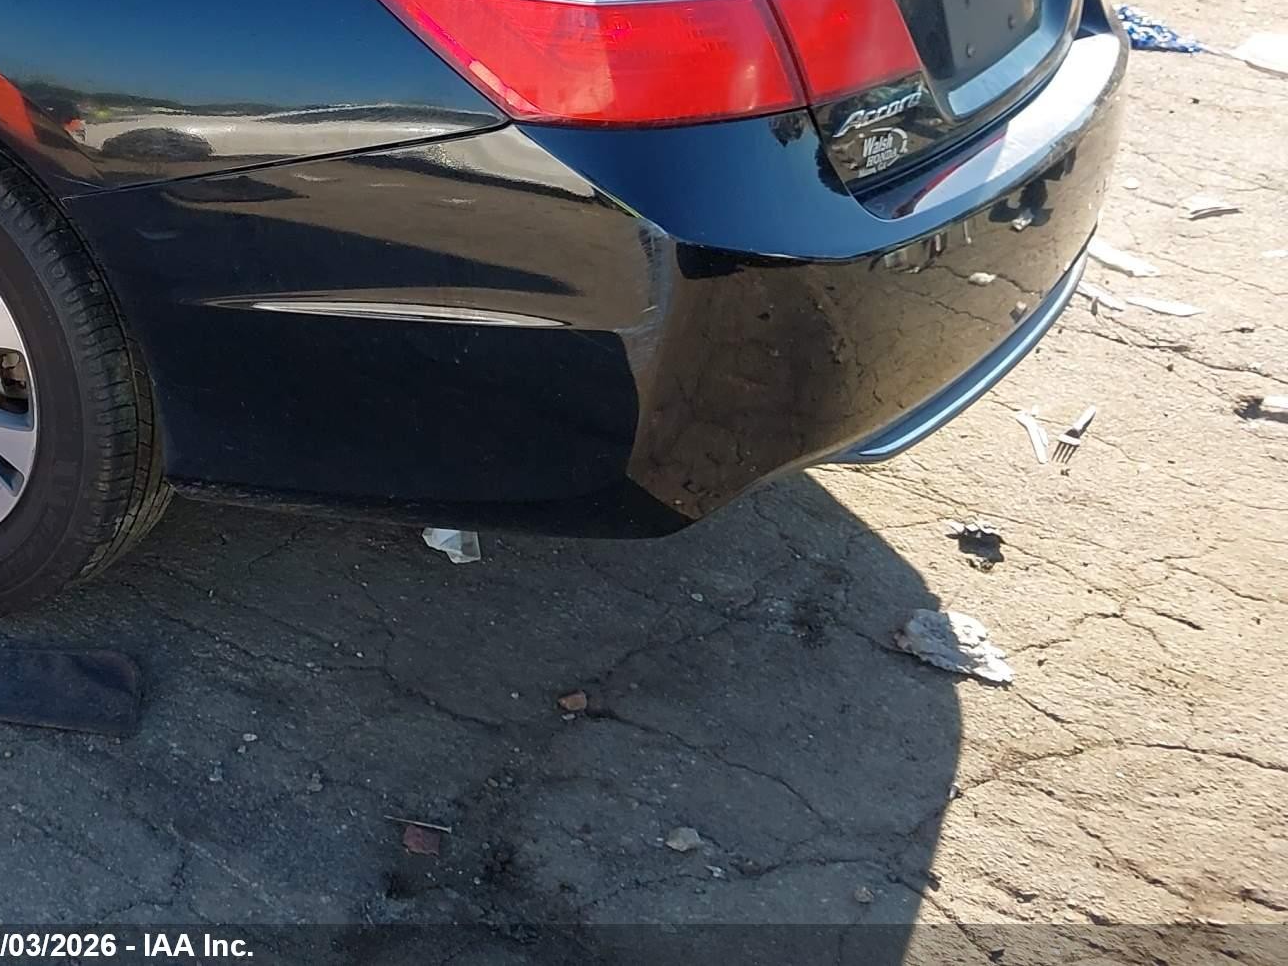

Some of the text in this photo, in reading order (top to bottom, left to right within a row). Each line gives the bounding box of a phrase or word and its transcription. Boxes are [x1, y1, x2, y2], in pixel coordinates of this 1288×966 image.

[832, 81, 928, 138] Accord
[862, 133, 894, 157] Walsh
[865, 148, 898, 168] HONDA
